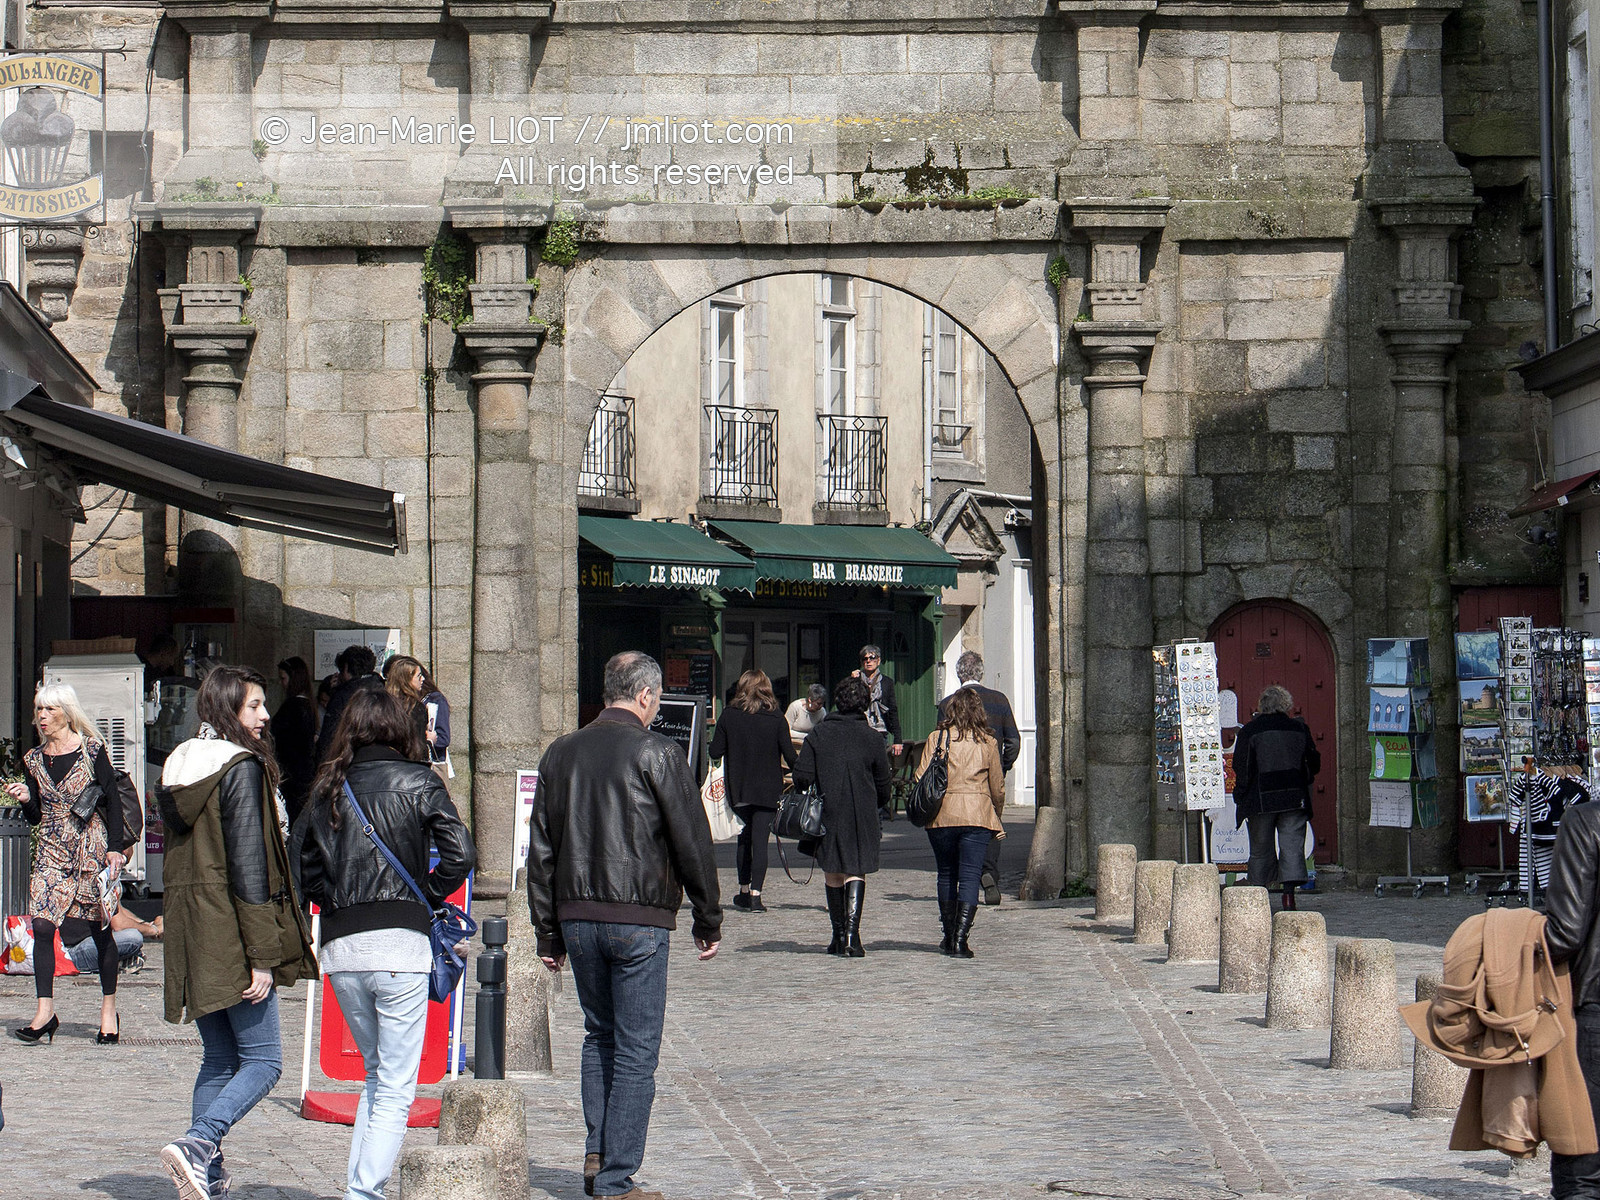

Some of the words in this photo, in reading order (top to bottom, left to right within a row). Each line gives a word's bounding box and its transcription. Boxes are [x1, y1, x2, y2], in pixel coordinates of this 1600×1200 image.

[649, 565, 666, 583] LE
[670, 566, 720, 586] SINAGOT
[812, 562, 836, 580] BAR
[845, 564, 903, 583] BRASSERIE
